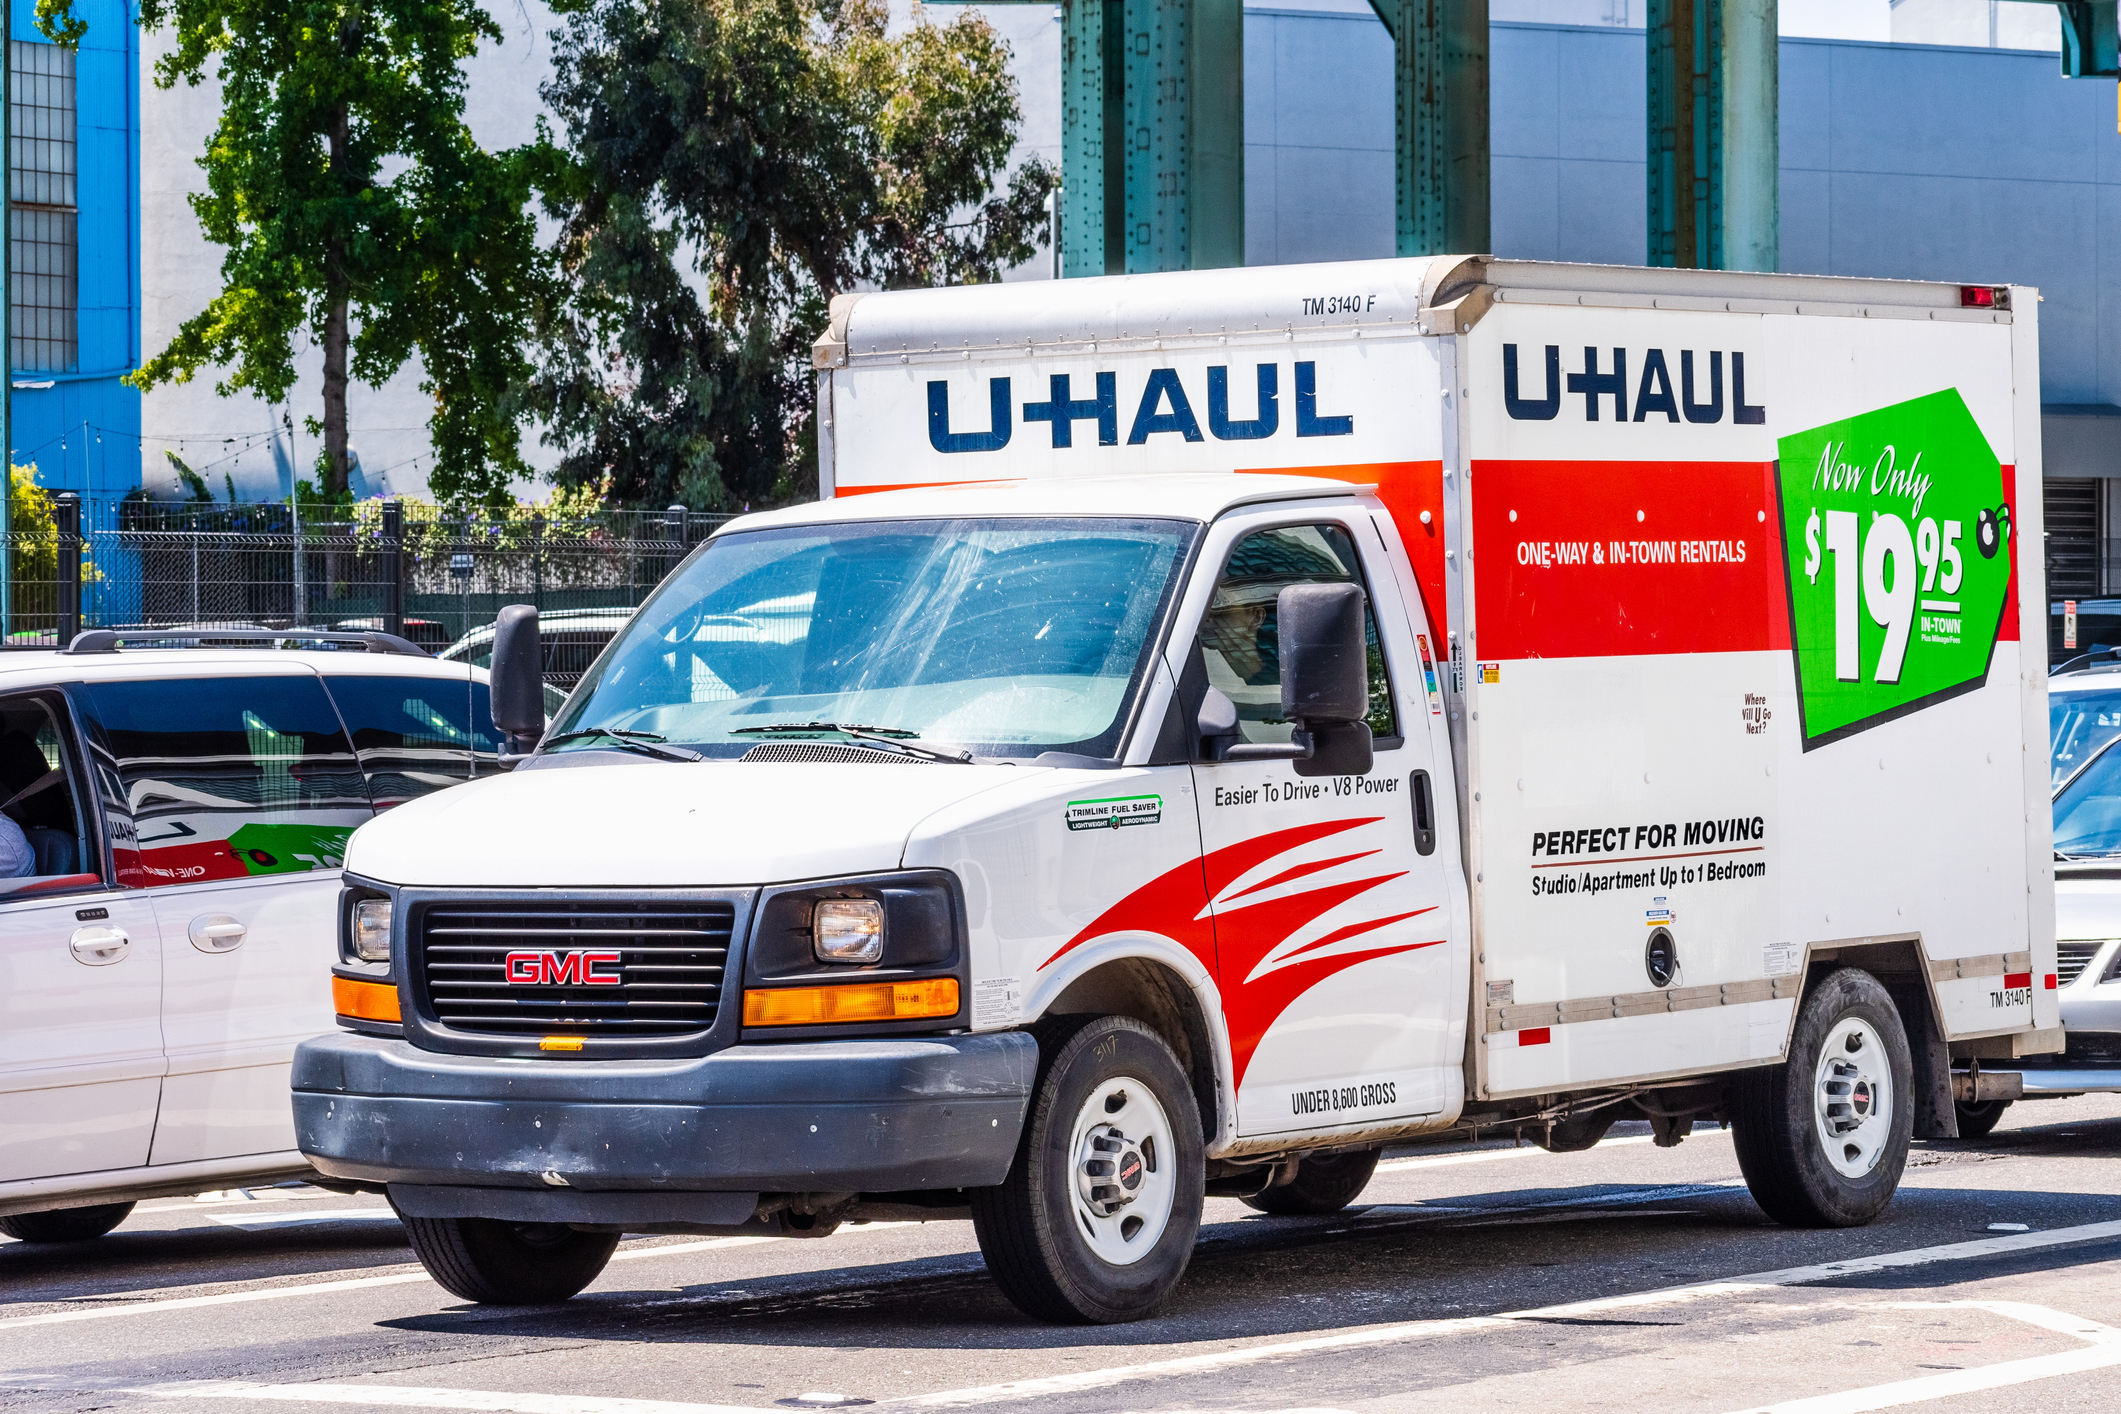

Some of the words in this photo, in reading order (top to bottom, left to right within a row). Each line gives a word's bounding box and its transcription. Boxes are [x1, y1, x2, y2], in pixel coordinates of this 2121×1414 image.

[1302, 297, 1325, 315] TM
[1328, 295, 1361, 314] 3140
[1366, 294, 1376, 312] F
[1503, 343, 1766, 425] U-HAUL
[927, 361, 1354, 453] U-HAUL
[1812, 441, 1867, 492] Now
[1871, 444, 1933, 520] Only
[1517, 541, 1588, 565] ONE-WAY
[1592, 541, 1605, 565] &
[1680, 540, 1746, 563] RENTALS
[1745, 693, 1766, 705] Where
[1746, 721, 1767, 734] Next?
[1755, 707, 1761, 723] U
[1763, 708, 1771, 720] Go
[1215, 785, 1258, 807] Easier
[1262, 783, 1279, 803] To
[1283, 780, 1320, 801] Drive
[1333, 776, 1351, 796] V8
[1356, 775, 1399, 795] Power
[1072, 820, 1108, 829] LIGHTWEIGHT
[1122, 815, 1158, 825] AERODYNAMIC
[1111, 805, 1130, 814] FUEL
[1532, 827, 1630, 856] PERFECT
[1635, 823, 1677, 850] FOR
[1683, 816, 1764, 846] MOVING
[1532, 868, 1656, 896] Studio/Apartment
[1660, 866, 1678, 889] Up
[1681, 865, 1695, 884] to
[1697, 864, 1704, 883] 1
[1706, 860, 1766, 881] Bedroom
[506, 951, 621, 985] GMC
[1990, 991, 2004, 1008] TM
[2005, 989, 2025, 1007] 3140
[1292, 1089, 1330, 1115] UNDER
[1332, 1087, 1358, 1112] 8,600
[1360, 1082, 1396, 1107] GROSS
